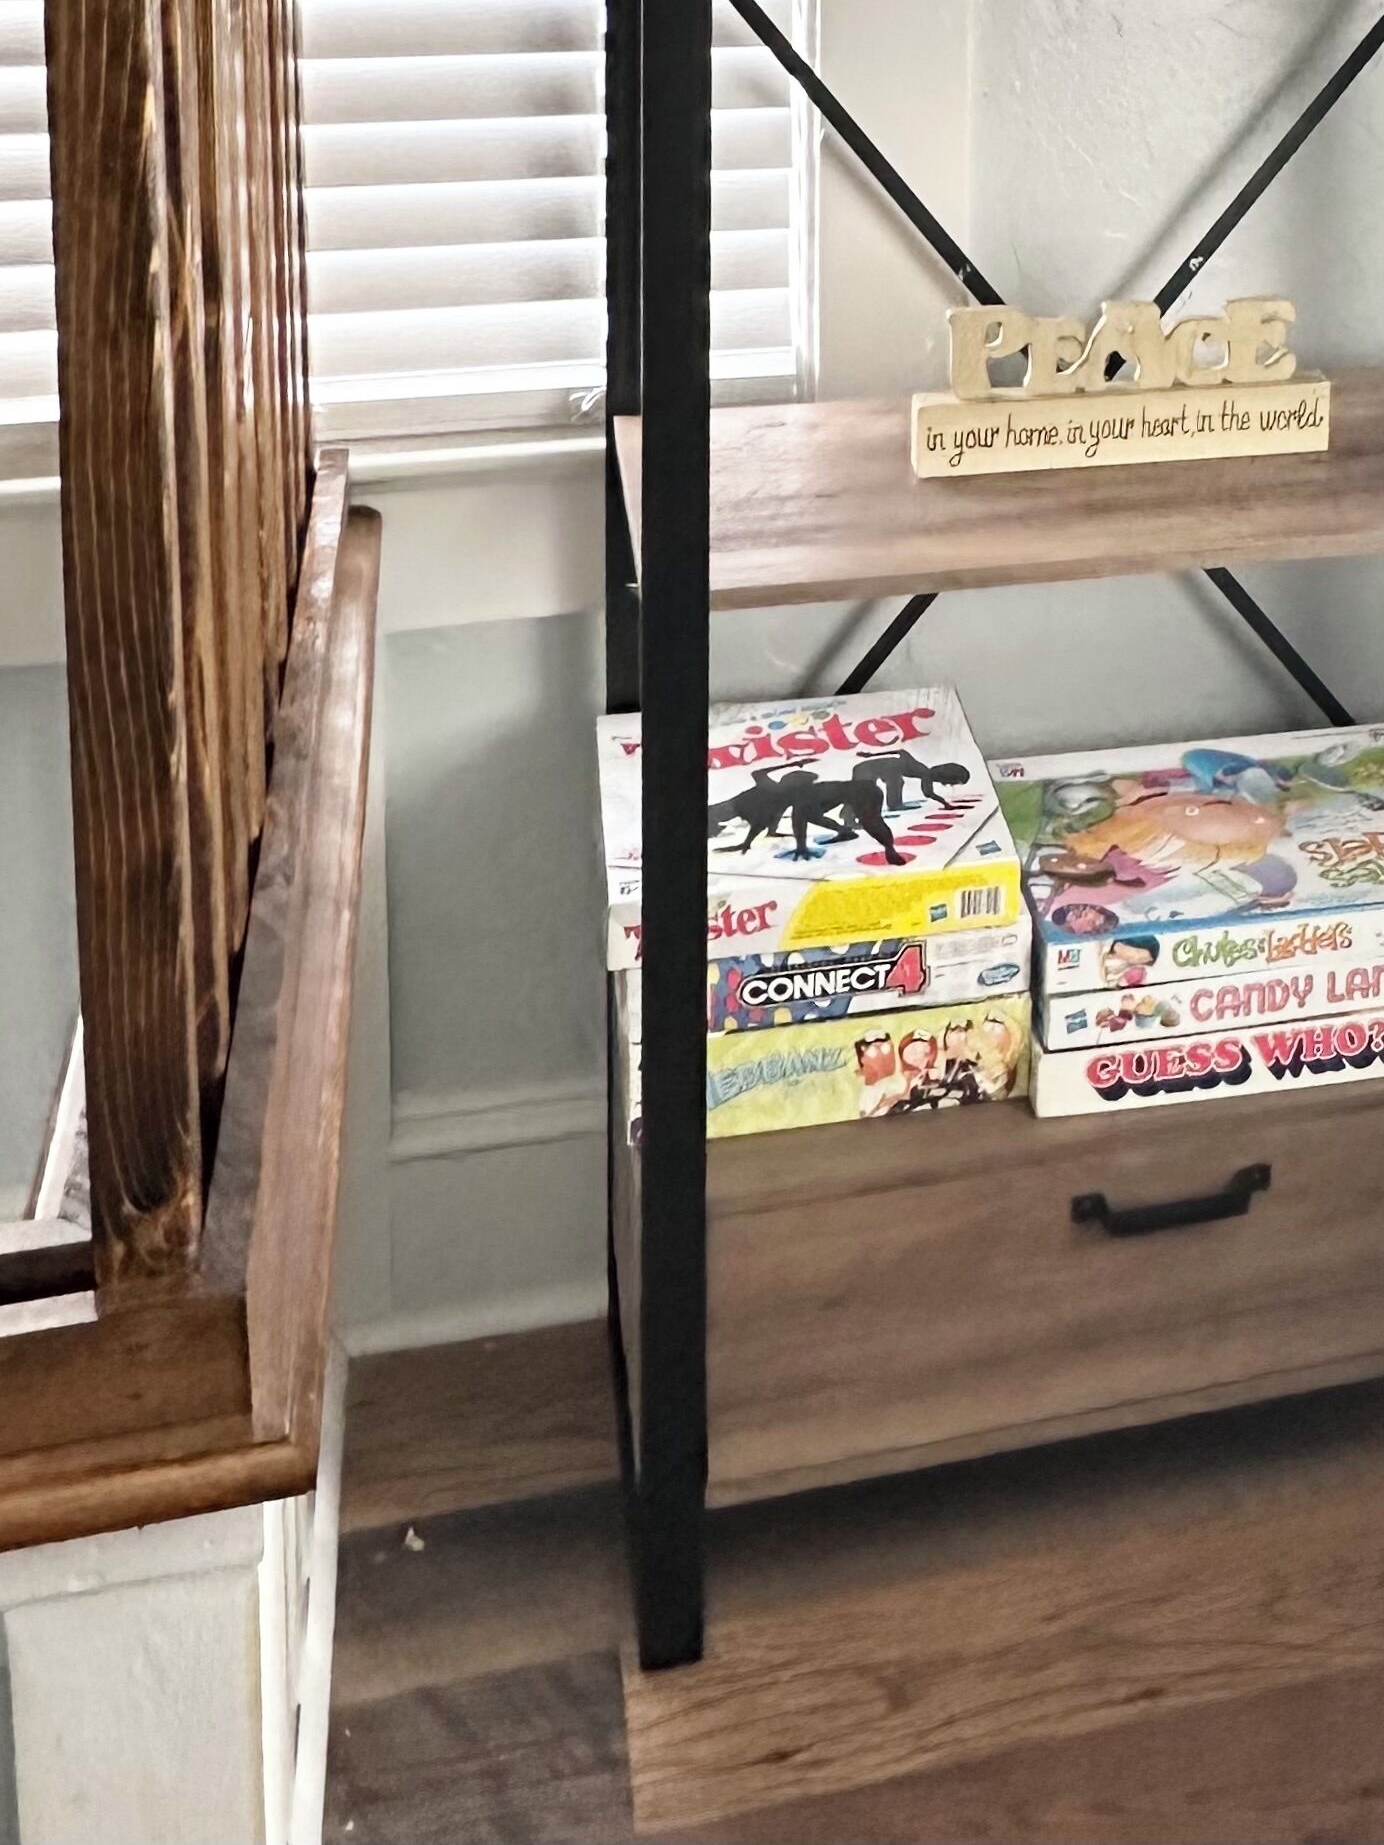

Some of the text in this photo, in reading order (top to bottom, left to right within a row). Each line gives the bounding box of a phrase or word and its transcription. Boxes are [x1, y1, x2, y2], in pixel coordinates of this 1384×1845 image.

[946, 297, 1296, 401] PEACE
[926, 426, 946, 451] in
[949, 425, 1000, 467] your
[1067, 419, 1086, 445] in
[1085, 417, 1135, 458] your
[1196, 410, 1215, 433] in
[1220, 400, 1250, 431] the
[741, 963, 891, 1006] CONNECT
[885, 943, 926, 995] 4
[1190, 974, 1313, 1022] CANDY
[1086, 1038, 1247, 1095] GUESS
